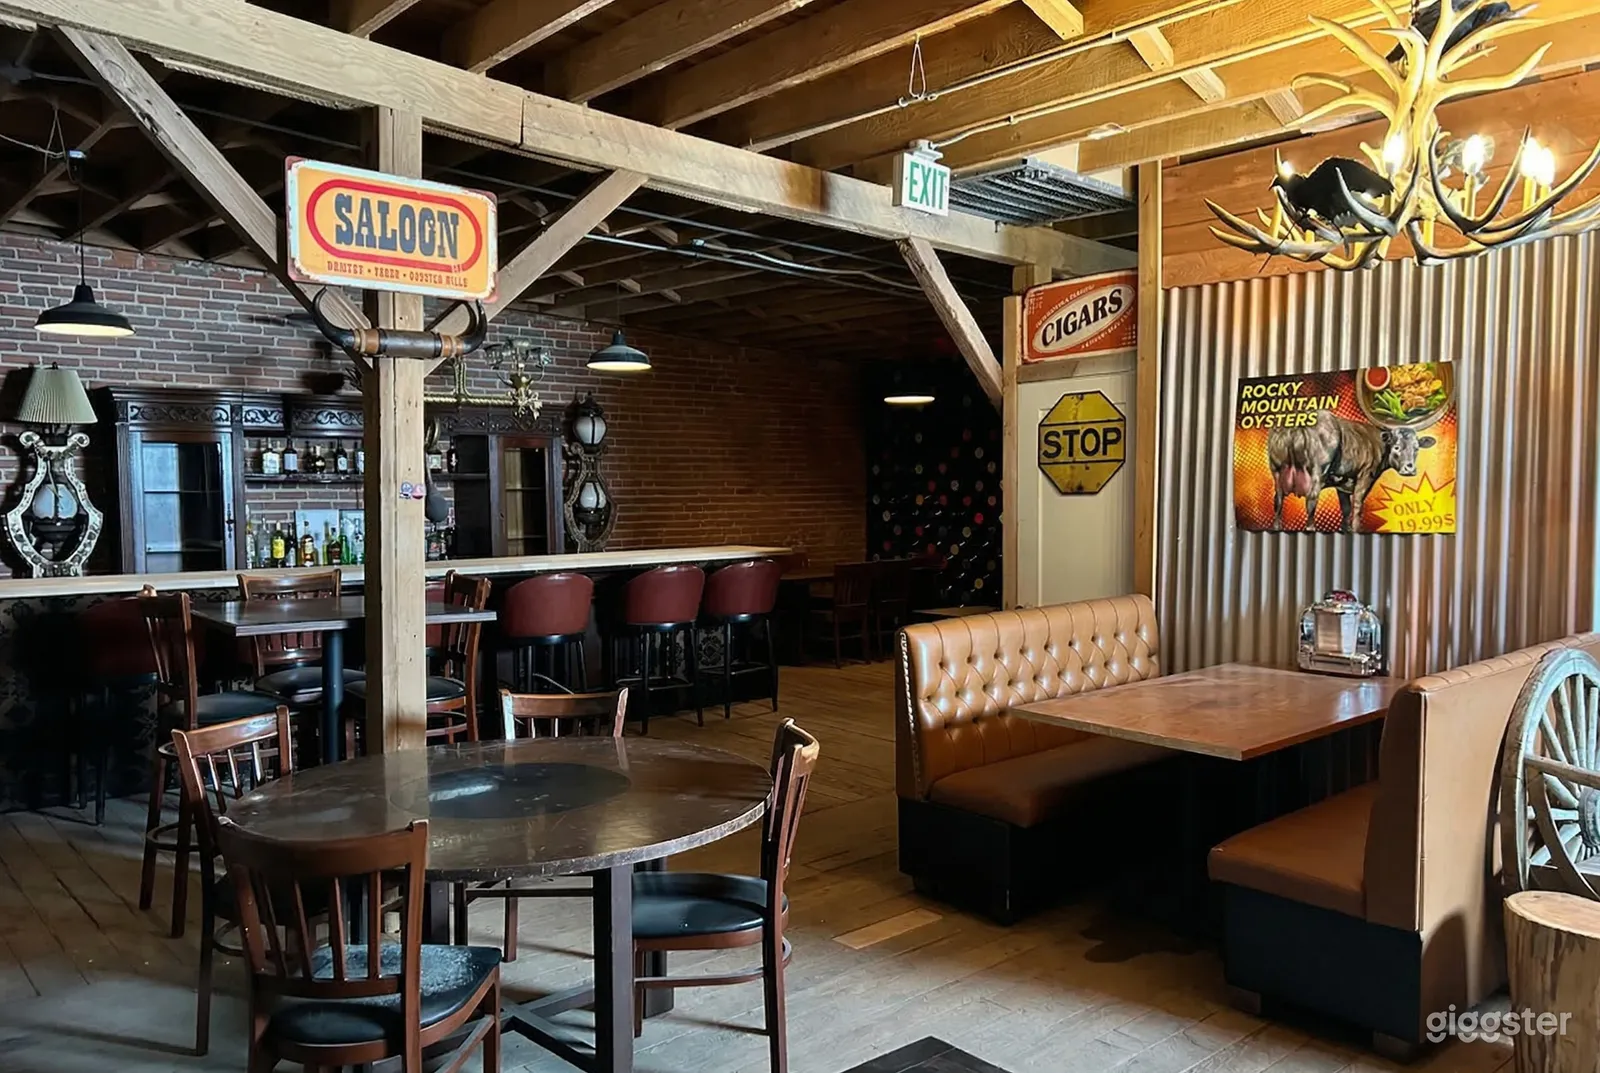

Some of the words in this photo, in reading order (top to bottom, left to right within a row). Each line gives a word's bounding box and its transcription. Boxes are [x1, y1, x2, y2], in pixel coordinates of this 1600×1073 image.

[908, 160, 947, 210] EXIT
[335, 192, 459, 260] SALOON
[1041, 288, 1123, 348] CIGARS
[1242, 381, 1304, 399] ROCKY
[1241, 395, 1339, 415] MOUNTAIN
[1241, 412, 1318, 430] OYSTERS
[1042, 427, 1122, 459] STOP
[1393, 495, 1436, 517] ONLY
